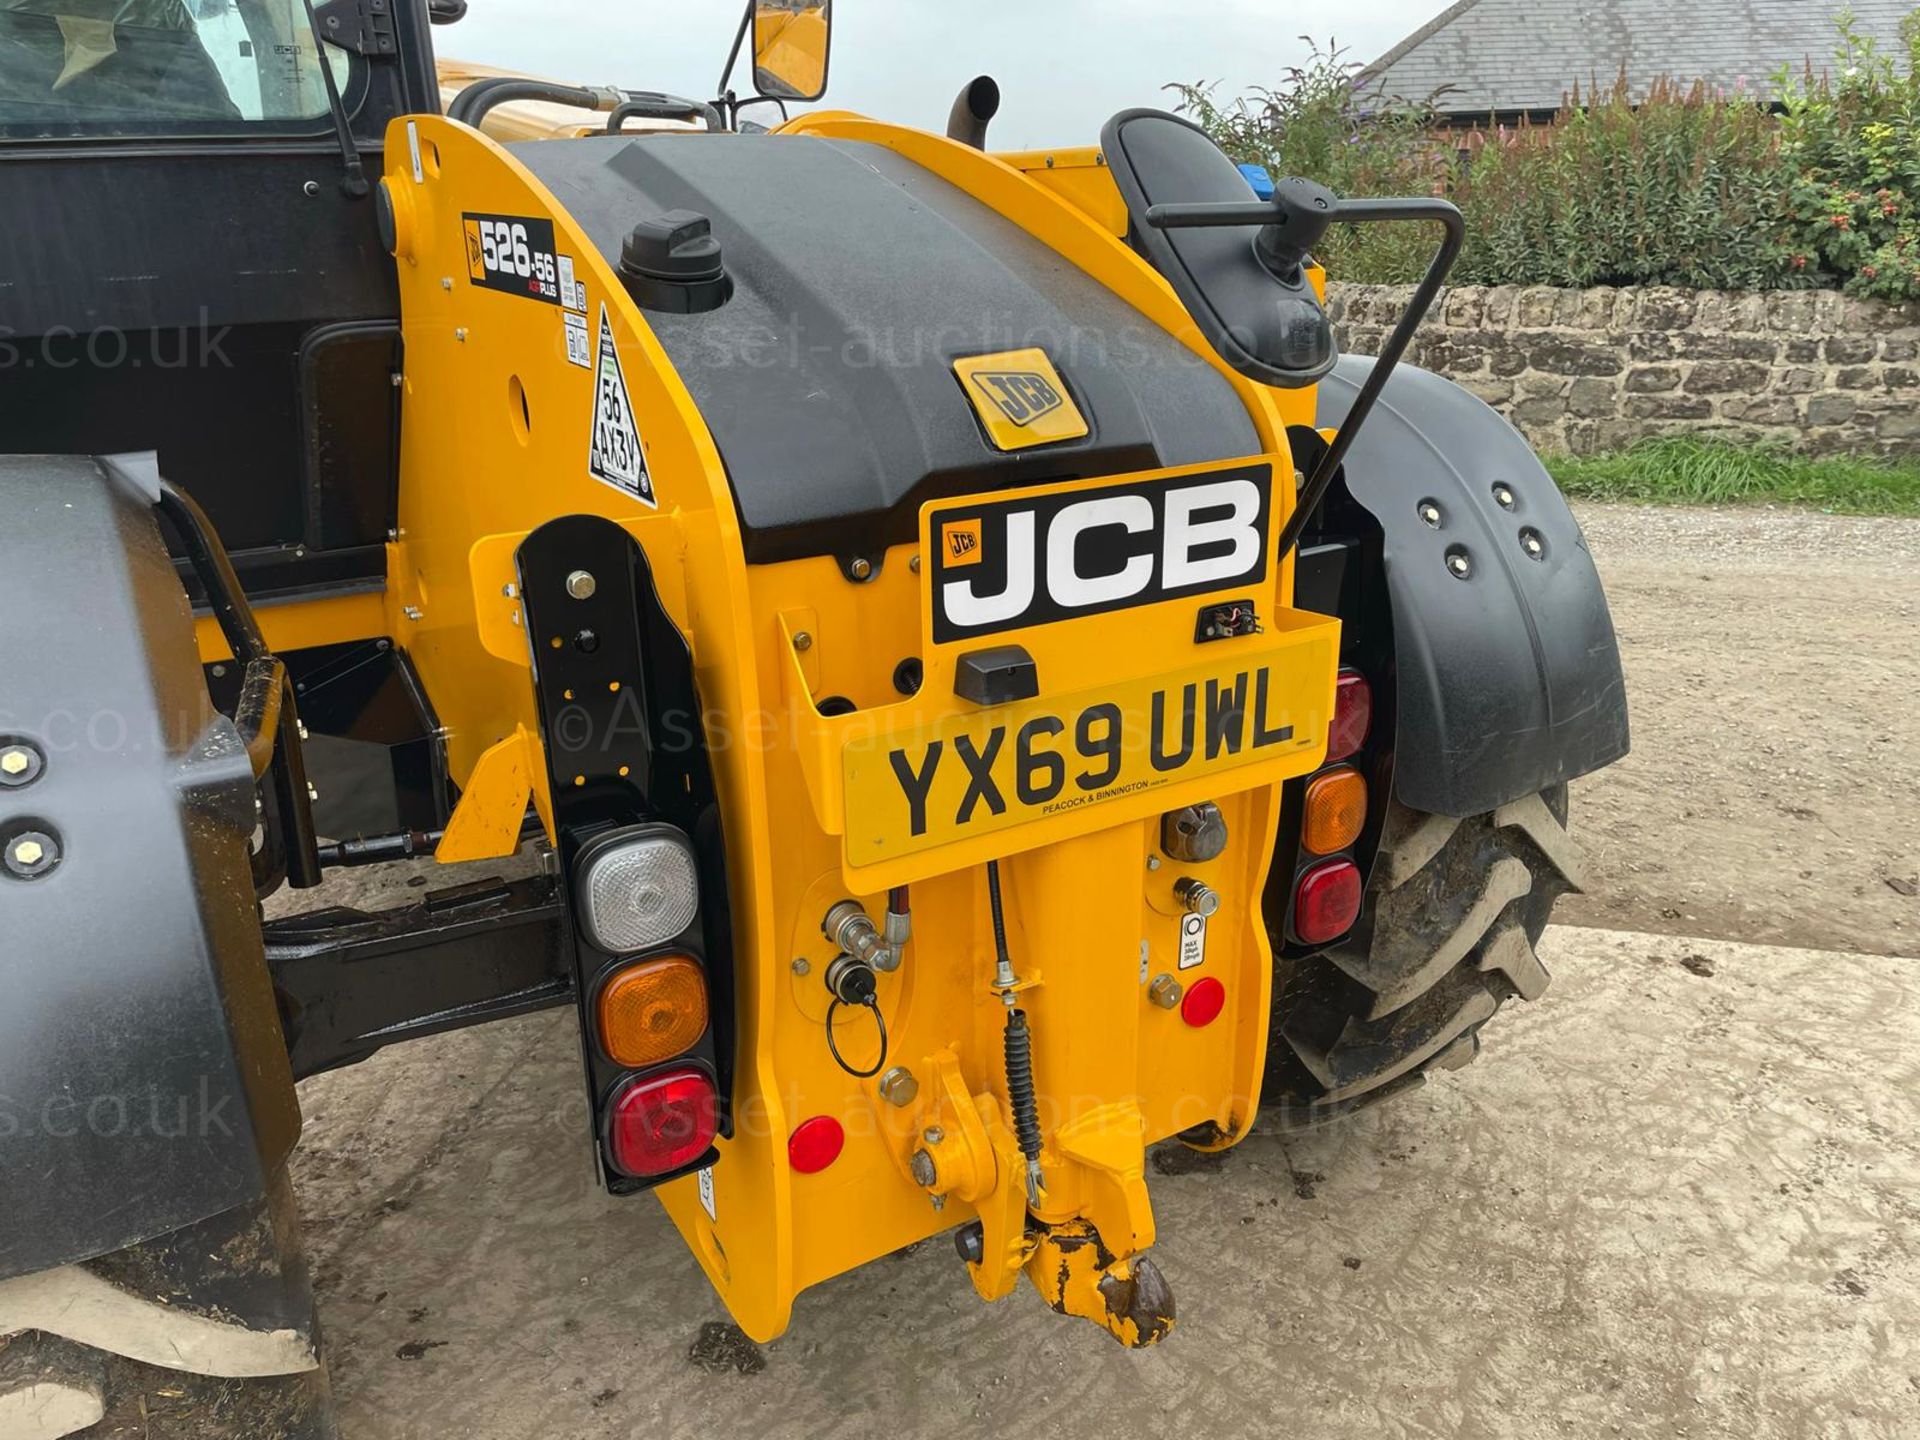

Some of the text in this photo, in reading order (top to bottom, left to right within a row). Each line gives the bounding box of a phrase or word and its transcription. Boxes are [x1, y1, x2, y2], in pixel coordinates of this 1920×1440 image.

[603, 378, 621, 424] 56
[990, 376, 1061, 420] JCB
[943, 479, 1261, 627] JCB
[951, 530, 976, 557] JCB
[889, 666, 1294, 837] YX69 UWL
[1042, 796, 1086, 814] PEACOCK
[1096, 779, 1149, 801] BINNINGTON
